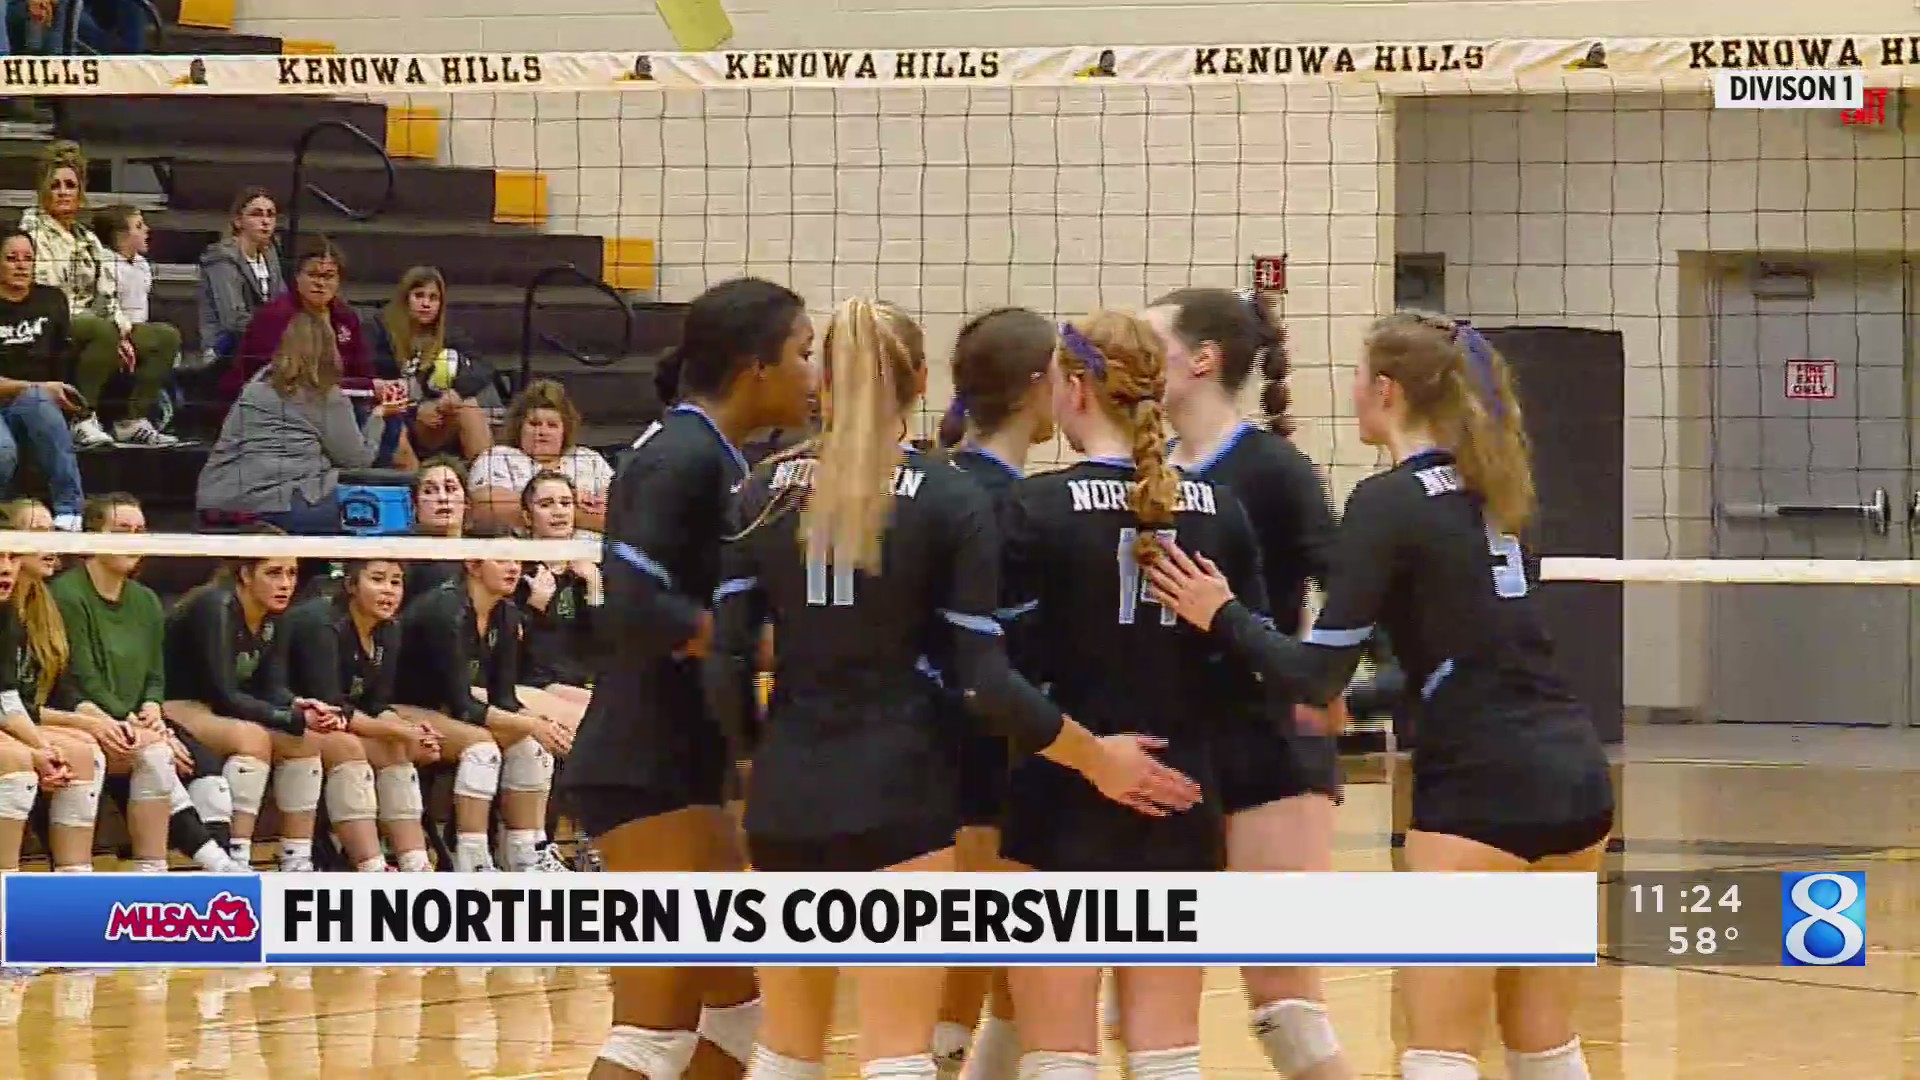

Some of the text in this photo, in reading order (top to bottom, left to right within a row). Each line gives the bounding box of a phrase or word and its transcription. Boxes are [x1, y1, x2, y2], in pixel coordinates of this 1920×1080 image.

[725, 51, 999, 79] KENOWA HILLS
[1194, 44, 1484, 74] KENOWA HILLS
[1689, 38, 1862, 68] KENOWA
[4, 58, 99, 86] HILLS
[278, 55, 542, 85] KENOWA HILLS
[1067, 479, 1216, 516] NORERN
